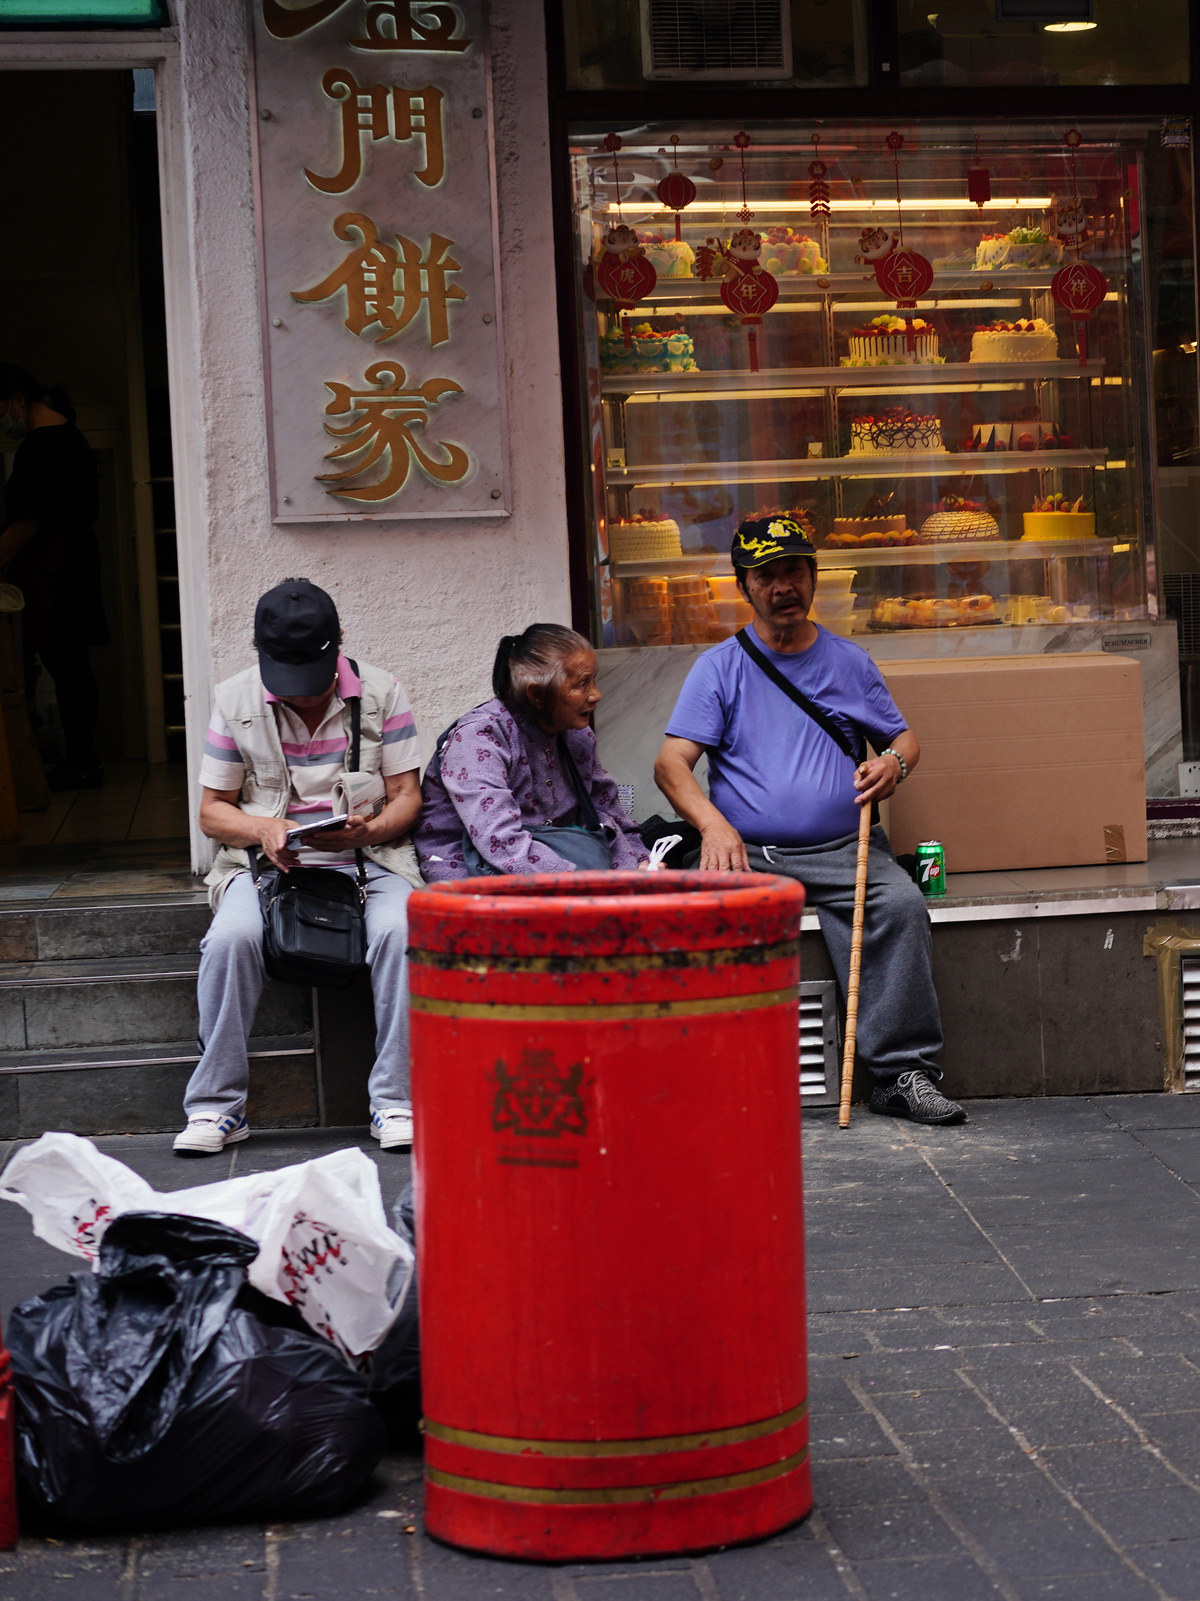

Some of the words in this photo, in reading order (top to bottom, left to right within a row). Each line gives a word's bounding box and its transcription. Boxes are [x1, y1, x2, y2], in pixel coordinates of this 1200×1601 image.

[620, 268, 635, 283] 虎
[896, 266, 912, 283] 吉
[741, 284, 758, 300] 年
[1070, 279, 1087, 296] 祥
[1103, 638, 1149, 647] SCHUMACHER
